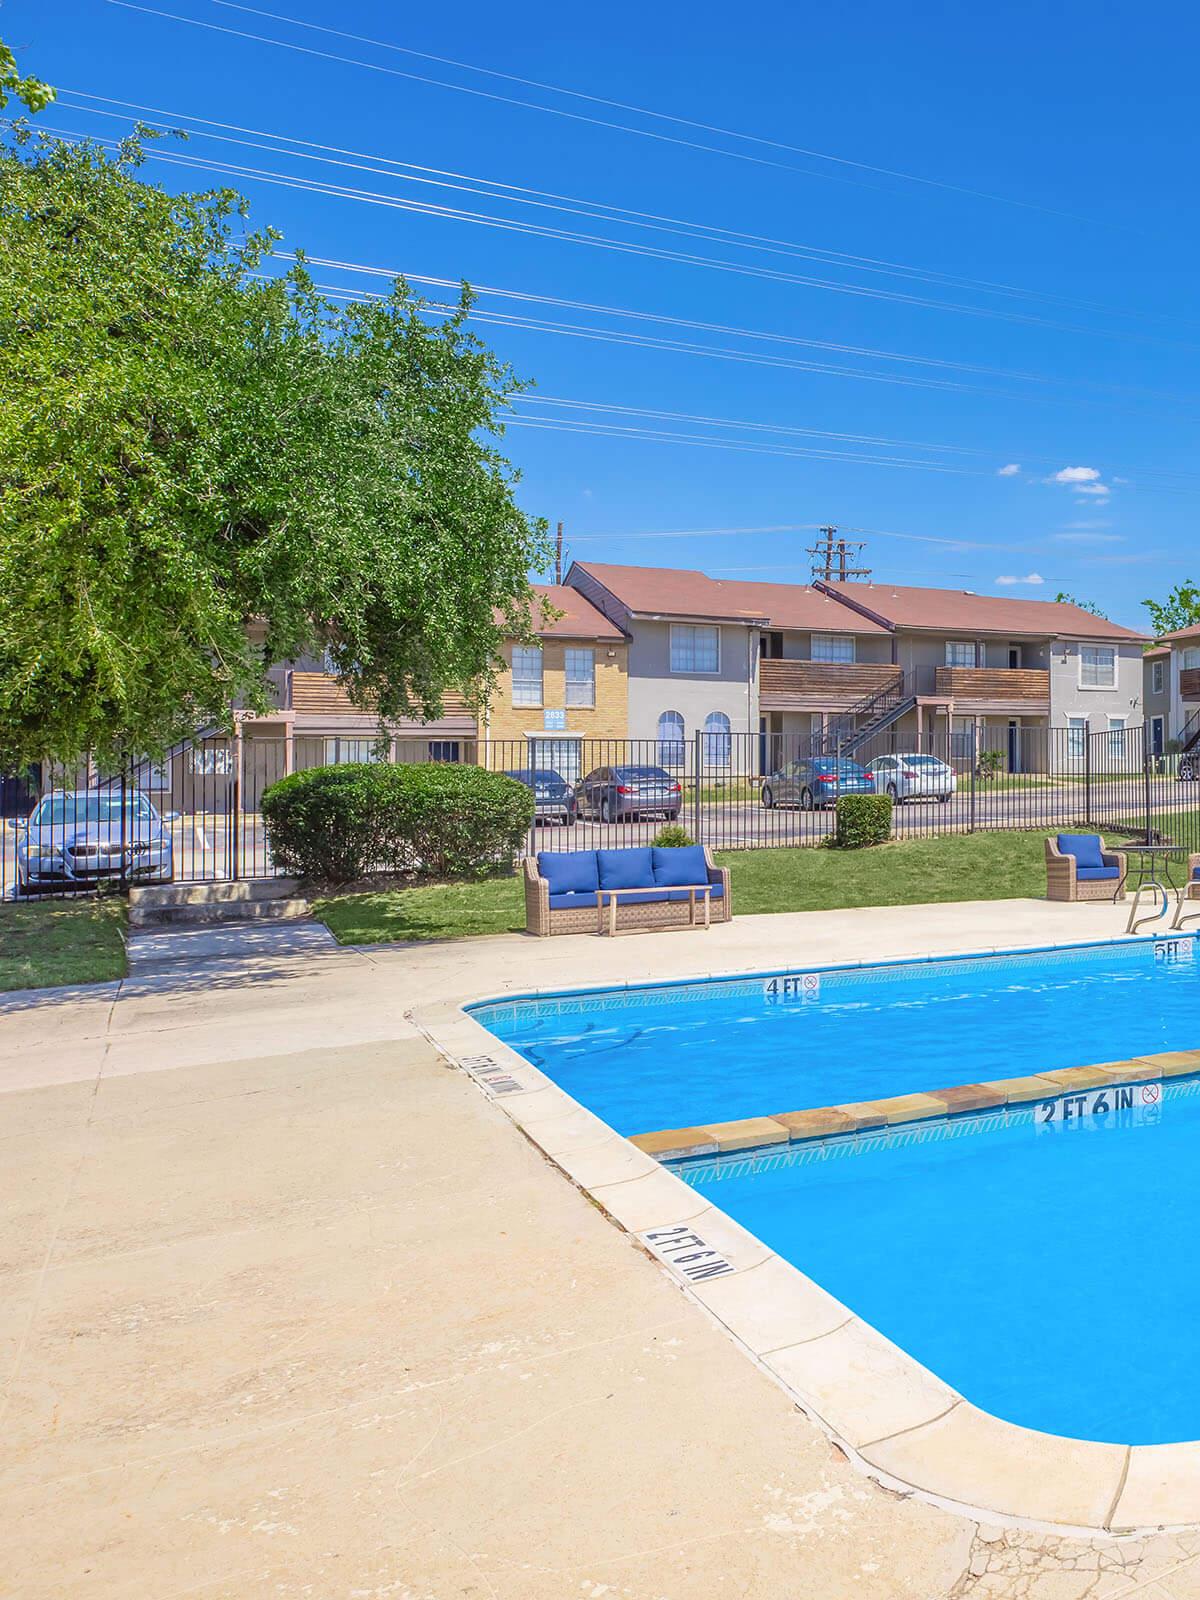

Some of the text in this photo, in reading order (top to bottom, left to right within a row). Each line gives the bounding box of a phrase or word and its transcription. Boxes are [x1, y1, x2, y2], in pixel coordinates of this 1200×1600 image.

[1167, 941, 1179, 956] FT
[766, 978, 800, 994] 4 FT
[1041, 1088, 1133, 1122] 2 FT 6 IN
[646, 1227, 734, 1280] 2 FT 6 IN
